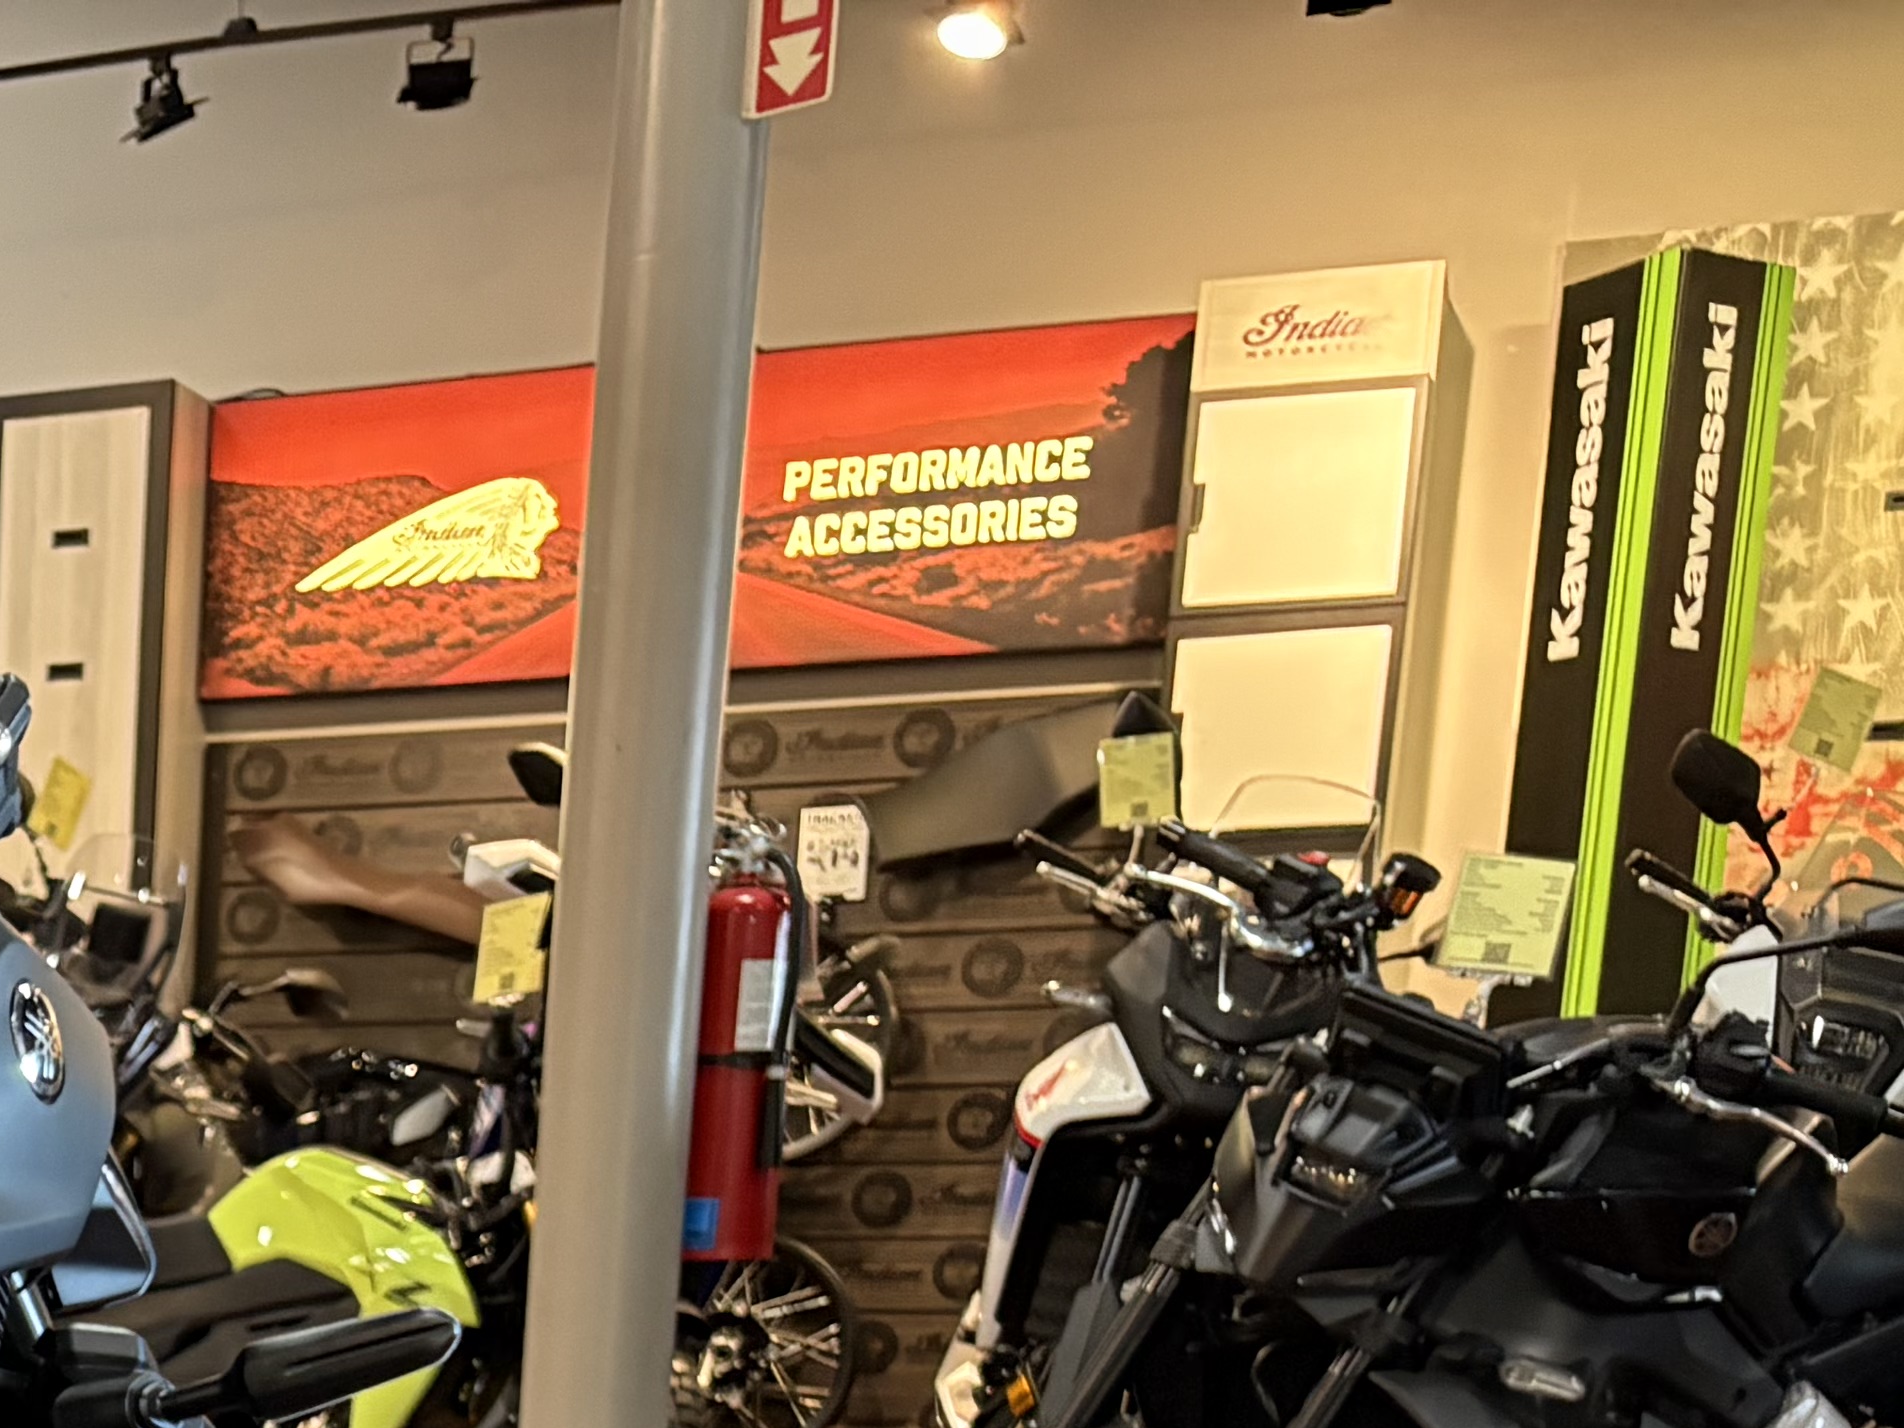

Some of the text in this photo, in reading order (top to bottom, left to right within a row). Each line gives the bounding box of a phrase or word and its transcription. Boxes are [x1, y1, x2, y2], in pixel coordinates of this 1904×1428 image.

[1242, 303, 1388, 347] India
[782, 435, 1095, 503] PERFORMANCE
[1547, 316, 1614, 662] Kawasaki
[1670, 302, 1739, 651] Kawasaki
[783, 494, 1079, 559] ACCESSORIES
